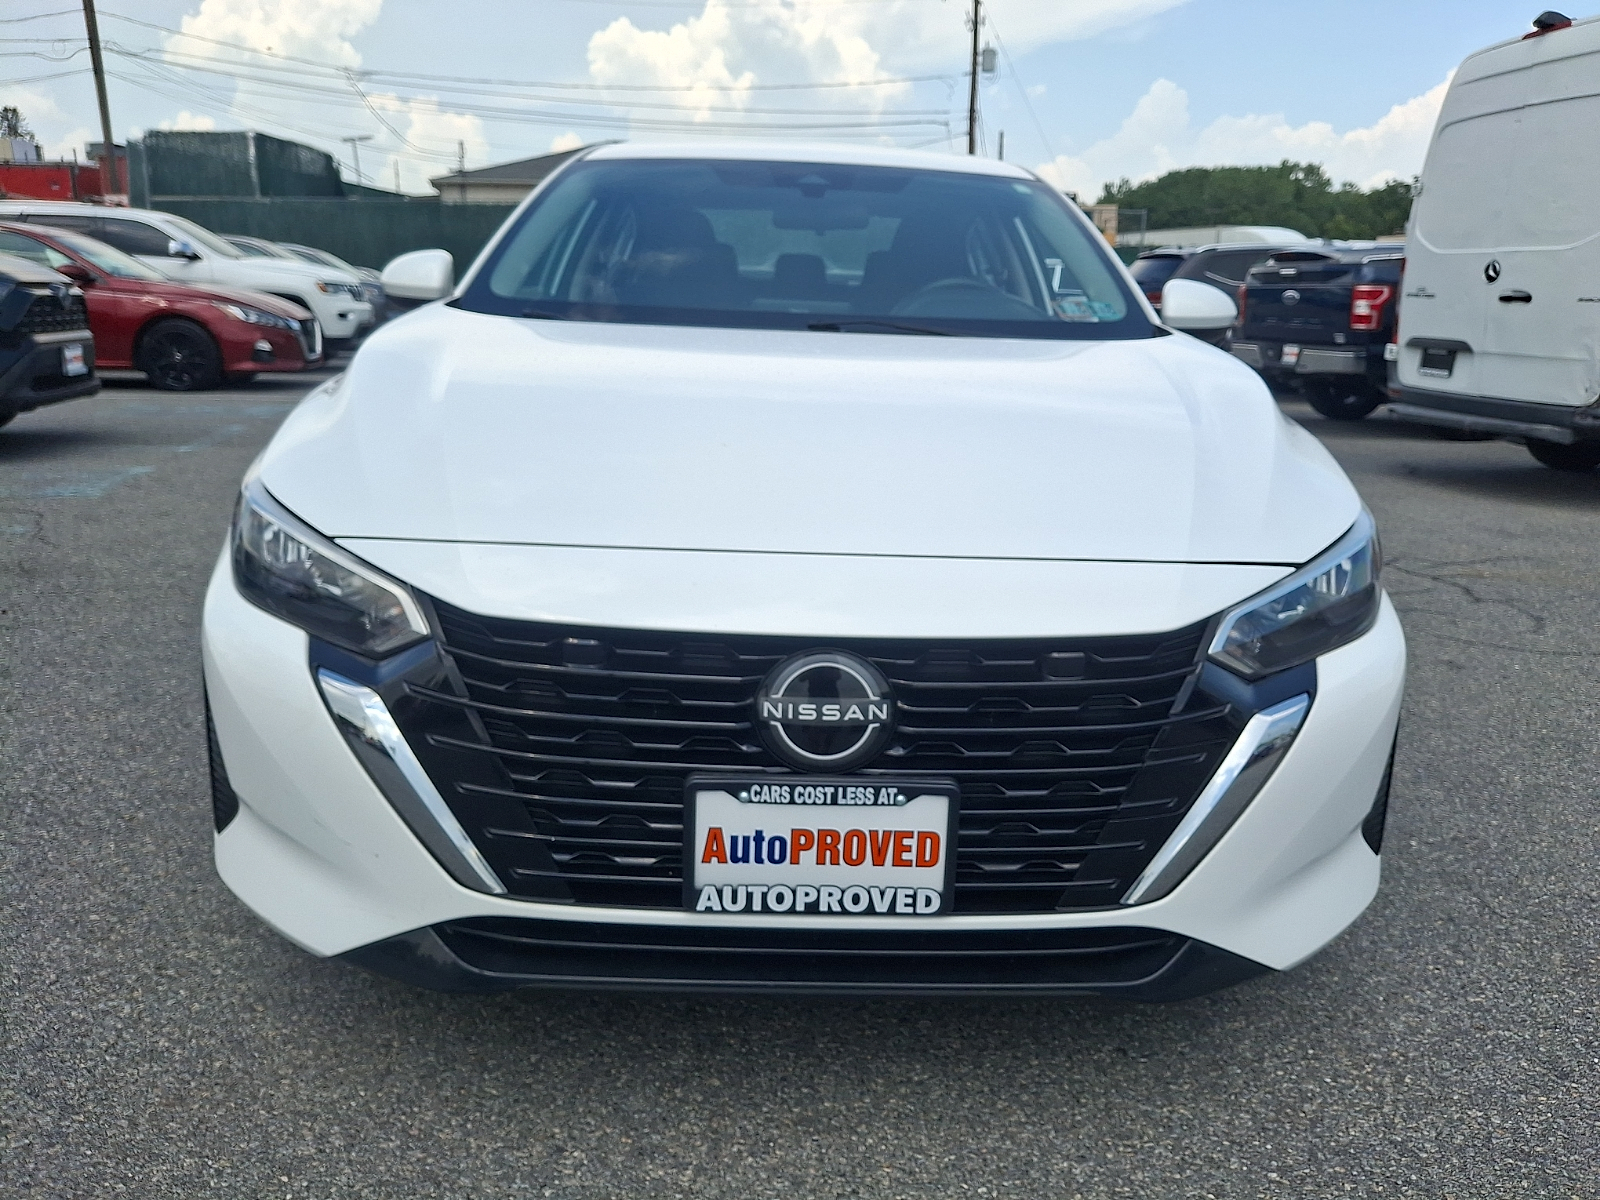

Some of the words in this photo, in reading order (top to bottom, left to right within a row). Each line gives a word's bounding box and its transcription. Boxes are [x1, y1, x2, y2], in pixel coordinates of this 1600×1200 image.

[762, 701, 889, 721] NISSAN
[750, 784, 791, 803] CARS
[794, 785, 835, 804] COST
[837, 787, 875, 805] LESS
[877, 787, 898, 805] AT
[701, 827, 941, 868] AutoPROVED
[696, 884, 941, 913] AUTOPROVED
